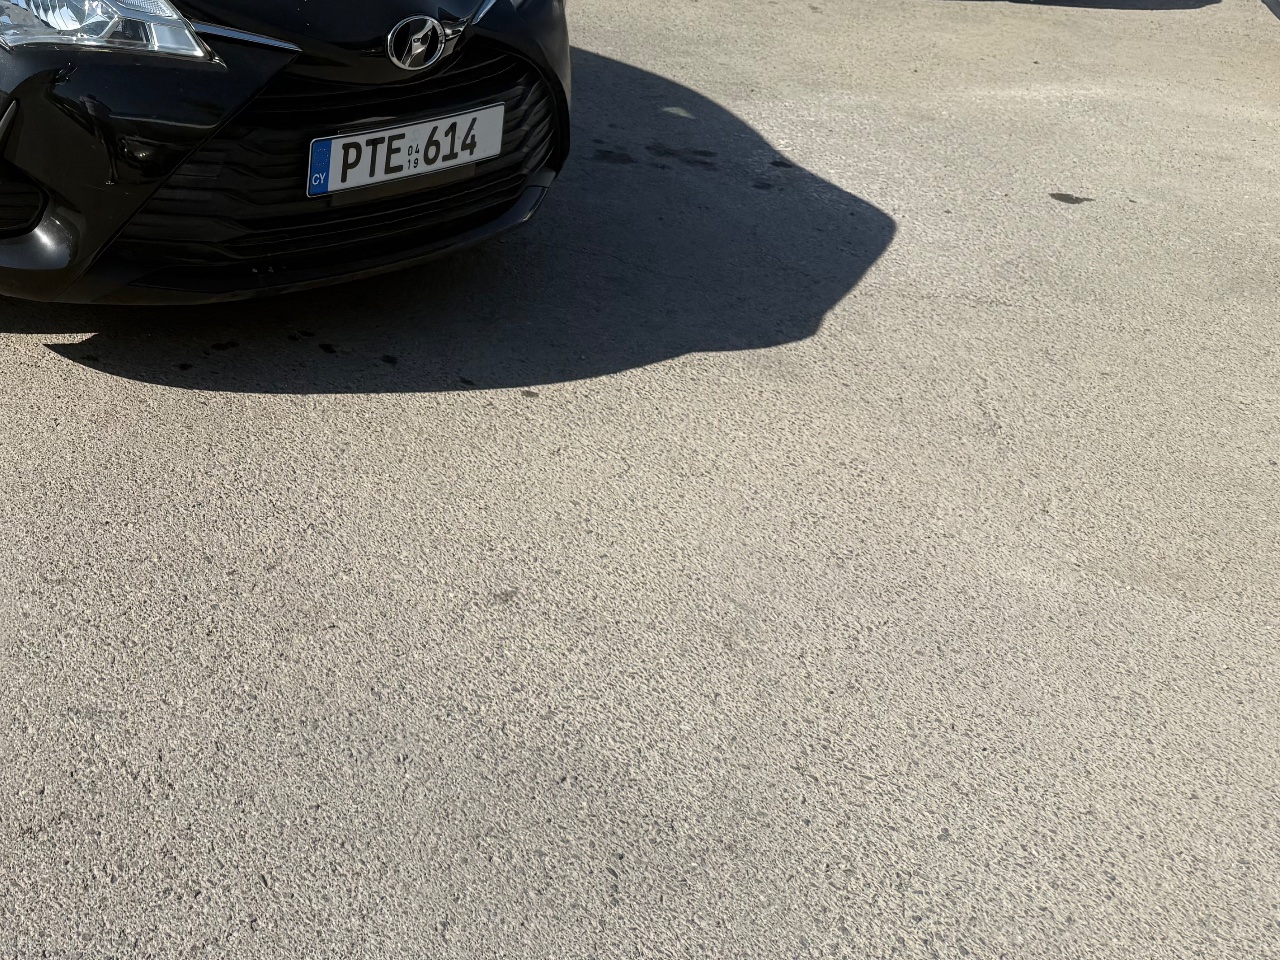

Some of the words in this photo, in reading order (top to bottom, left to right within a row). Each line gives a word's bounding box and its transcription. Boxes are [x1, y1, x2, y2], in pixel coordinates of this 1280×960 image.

[340, 133, 406, 183] PTE
[422, 117, 478, 166] 614
[407, 143, 420, 157] 04
[407, 157, 419, 170] 19
[311, 172, 326, 186] CY
